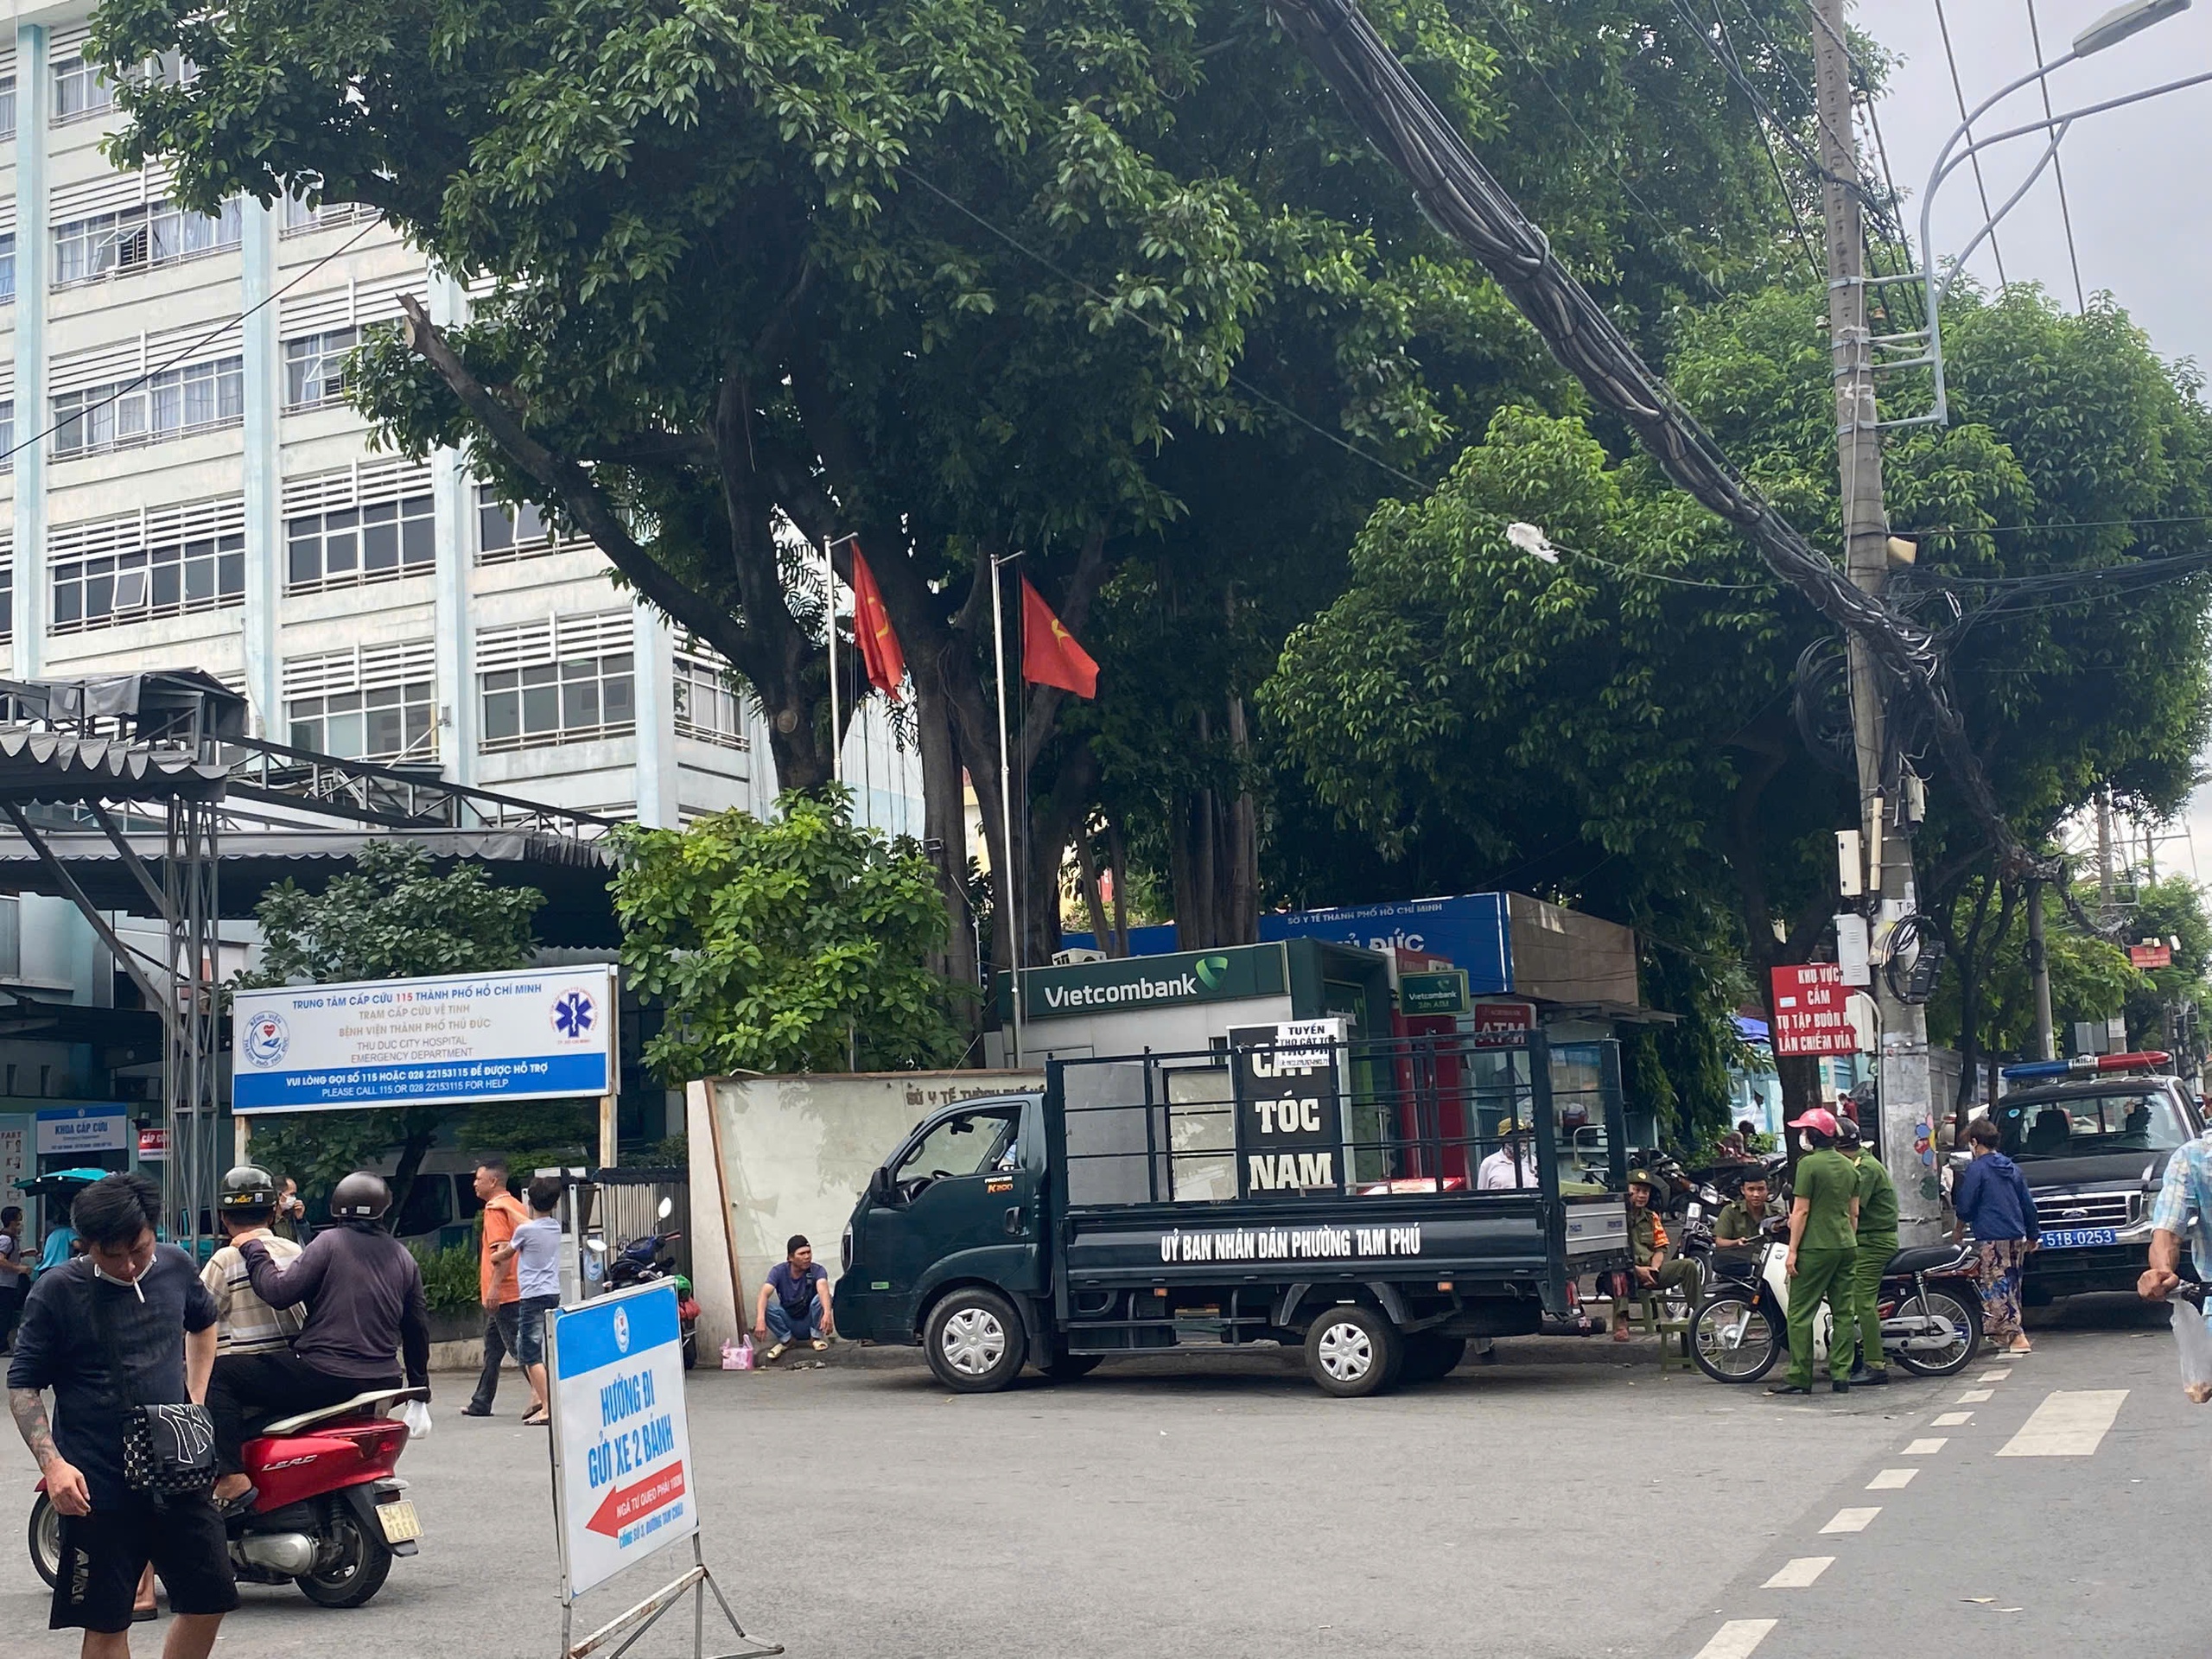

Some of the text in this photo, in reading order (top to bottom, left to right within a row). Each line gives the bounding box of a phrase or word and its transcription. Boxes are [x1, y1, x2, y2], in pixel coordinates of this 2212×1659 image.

[1357, 907, 1377, 918] PHỐ
[1396, 904, 1414, 914] CHÍ
[1417, 904, 1443, 912] MINH
[1798, 966, 1840, 986] KHU VỰC
[293, 999, 323, 1009] TRUNG
[327, 996, 346, 1007] TÂM
[349, 992, 370, 1005] CẤP
[372, 991, 393, 1003] CỨU
[397, 993, 413, 1002] 115
[416, 988, 448, 1001] THÀNH
[452, 985, 473, 999] PHỐ
[494, 982, 512, 995] CHÍ
[515, 984, 542, 994] MINH
[1045, 973, 1197, 1007] Vietcombank
[1408, 990, 1457, 1001] Vietcombank
[387, 1003, 409, 1018] CẤP
[410, 1003, 431, 1016] CỨU
[448, 1004, 470, 1014] TINH
[1791, 1012, 1811, 1032] TẬP
[1814, 1009, 1840, 1027] BUÔN
[339, 1025, 363, 1039] BỆNH
[366, 1024, 387, 1037] VIỆN
[390, 1020, 422, 1033] THÀNH
[425, 1019, 446, 1032] PHỐ
[469, 1017, 491, 1029] ĐỨC
[1478, 1021, 1525, 1044] ATM
[357, 1036, 467, 1052] THU DUC CITY HOSPITAL
[351, 1047, 474, 1064] EMERGENCY DEPARTMENT
[286, 1077, 301, 1087] VUI
[302, 1074, 327, 1086] LÒNG
[328, 1075, 346, 1086] GỌI
[347, 1071, 360, 1083] SỐ
[362, 1072, 378, 1082] 115
[379, 1070, 406, 1083] HOẶC
[408, 1071, 424, 1080] 028
[426, 1067, 468, 1079] 22153115
[322, 1078, 509, 1097] PLEASE CALL 115 OR 028 22153115 FOR HELP
[1255, 1090, 1320, 1134] TÓC
[55, 1123, 74, 1135] KHOA
[1249, 1153, 1333, 1190] NAM
[1182, 1234, 1211, 1261] BAN
[1215, 1228, 1255, 1260] NHÂN
[1258, 1226, 1288, 1259] DÂN
[1292, 1224, 1351, 1258] PHƯỜNG
[1356, 1229, 1386, 1256] TAM
[1390, 1222, 1421, 1255] PHÚ
[601, 1369, 655, 1427] HƯỚNG ĐI
[614, 1433, 632, 1477] XE
[632, 1428, 642, 1467] 2
[642, 1412, 674, 1462] BÁNH
